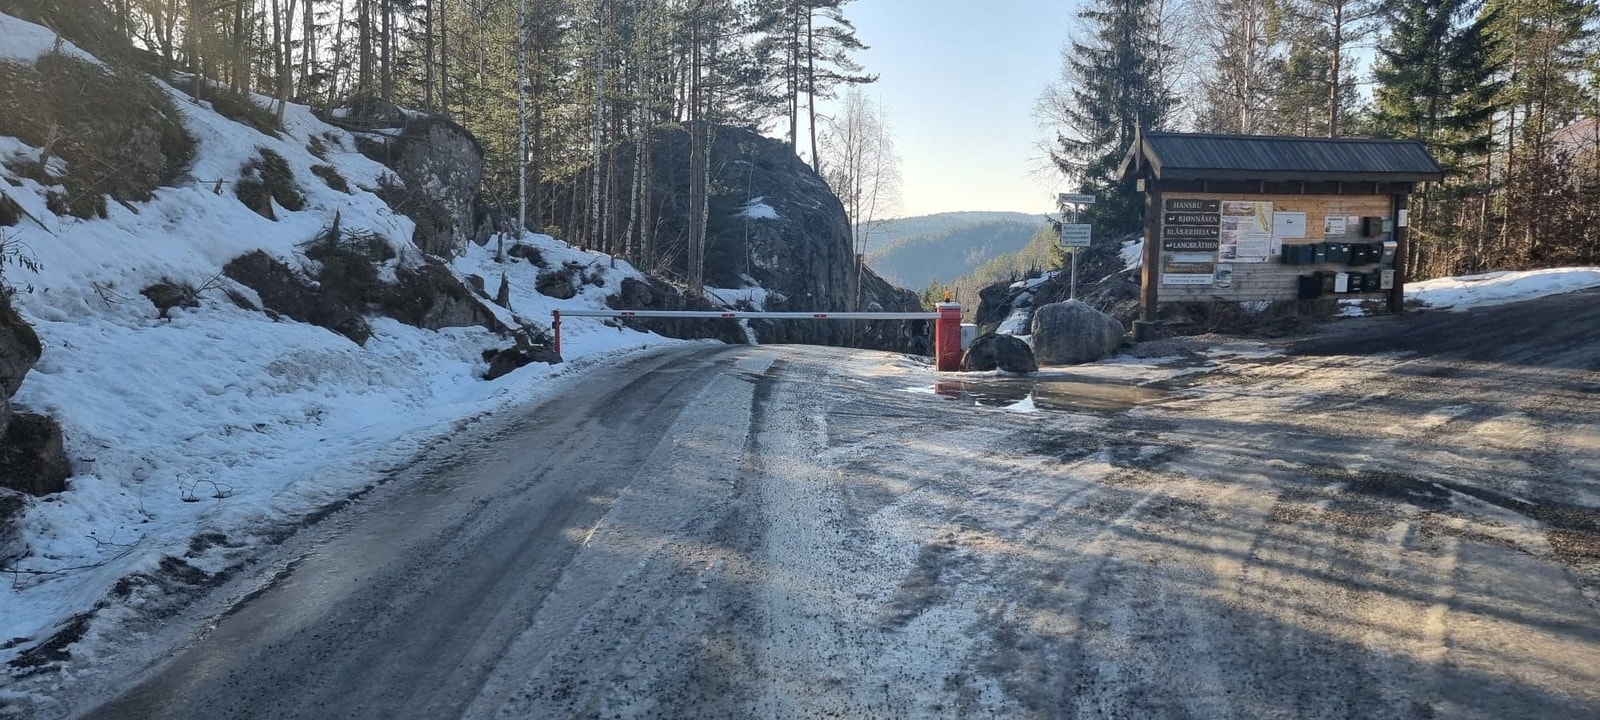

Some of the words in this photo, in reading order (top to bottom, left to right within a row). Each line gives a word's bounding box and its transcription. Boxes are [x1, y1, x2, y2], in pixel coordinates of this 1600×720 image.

[1173, 201, 1202, 209] HANSBU
[1178, 214, 1218, 223] BJØNNÅSEN
[1166, 228, 1209, 236] BLÅBÆRHEIA
[1173, 241, 1218, 249] LANGBRÅTHEN
